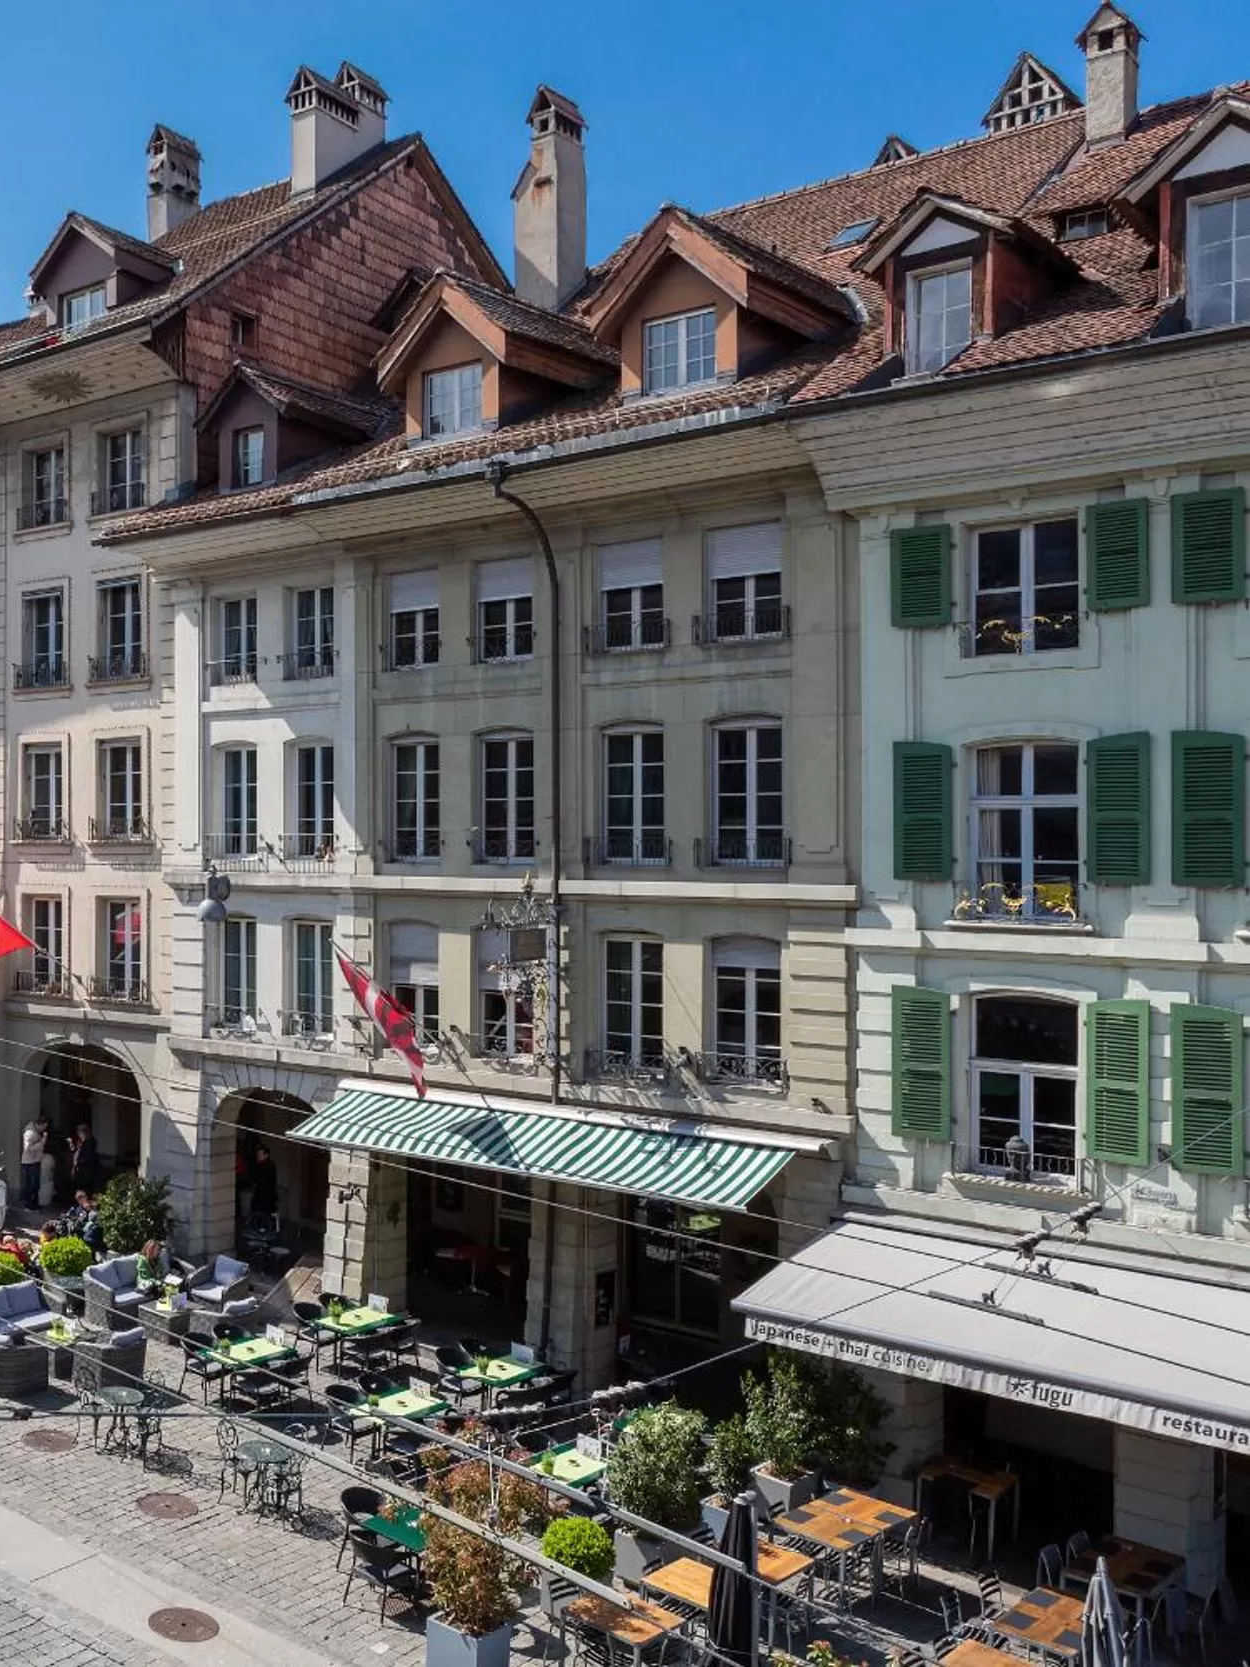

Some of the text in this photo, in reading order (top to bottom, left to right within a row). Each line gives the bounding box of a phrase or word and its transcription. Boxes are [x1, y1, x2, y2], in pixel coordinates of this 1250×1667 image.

[839, 1340, 868, 1358] thai
[1031, 1381, 1073, 1408] fugu
[1162, 1415, 1249, 1446] restaura
